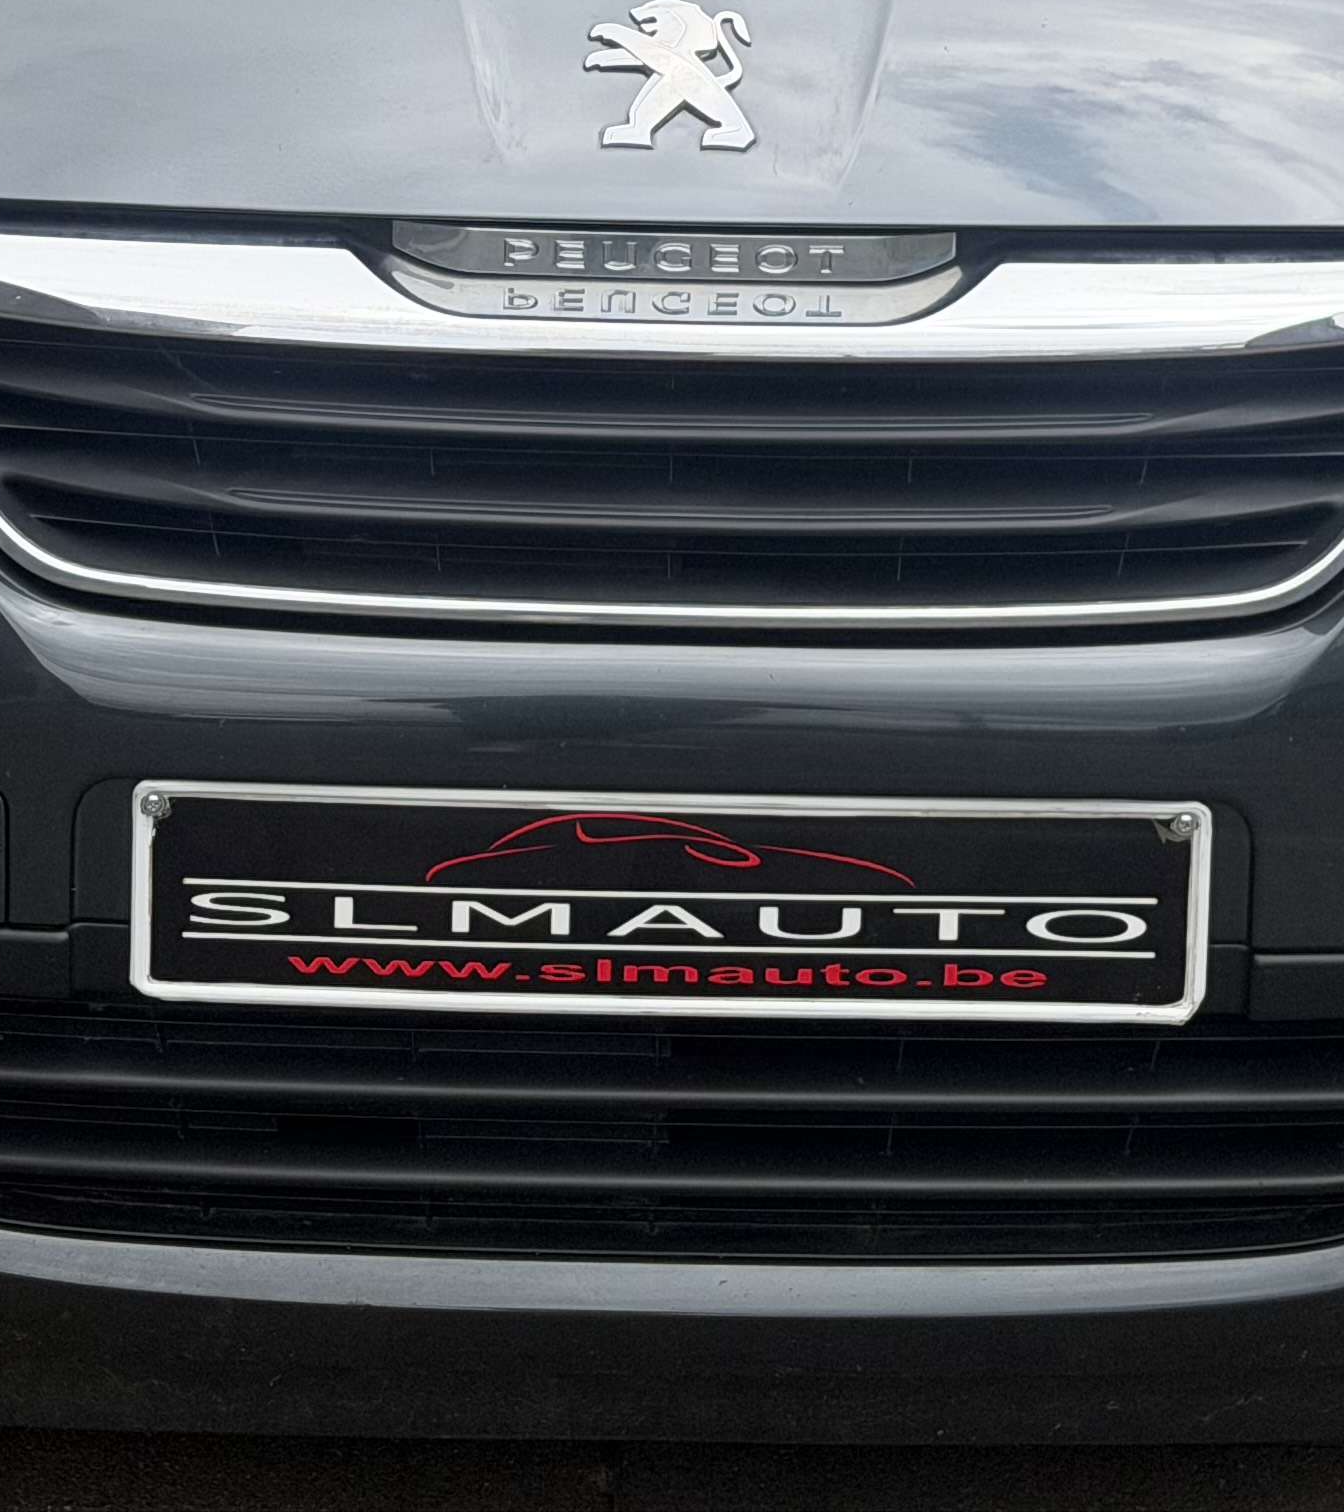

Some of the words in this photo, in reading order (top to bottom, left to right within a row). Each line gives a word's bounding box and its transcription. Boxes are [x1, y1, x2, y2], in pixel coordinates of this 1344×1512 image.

[503, 237, 846, 275] PEUGEOT
[189, 891, 1148, 943] SLMAUTO
[287, 955, 1048, 988] www.slmauto.be
